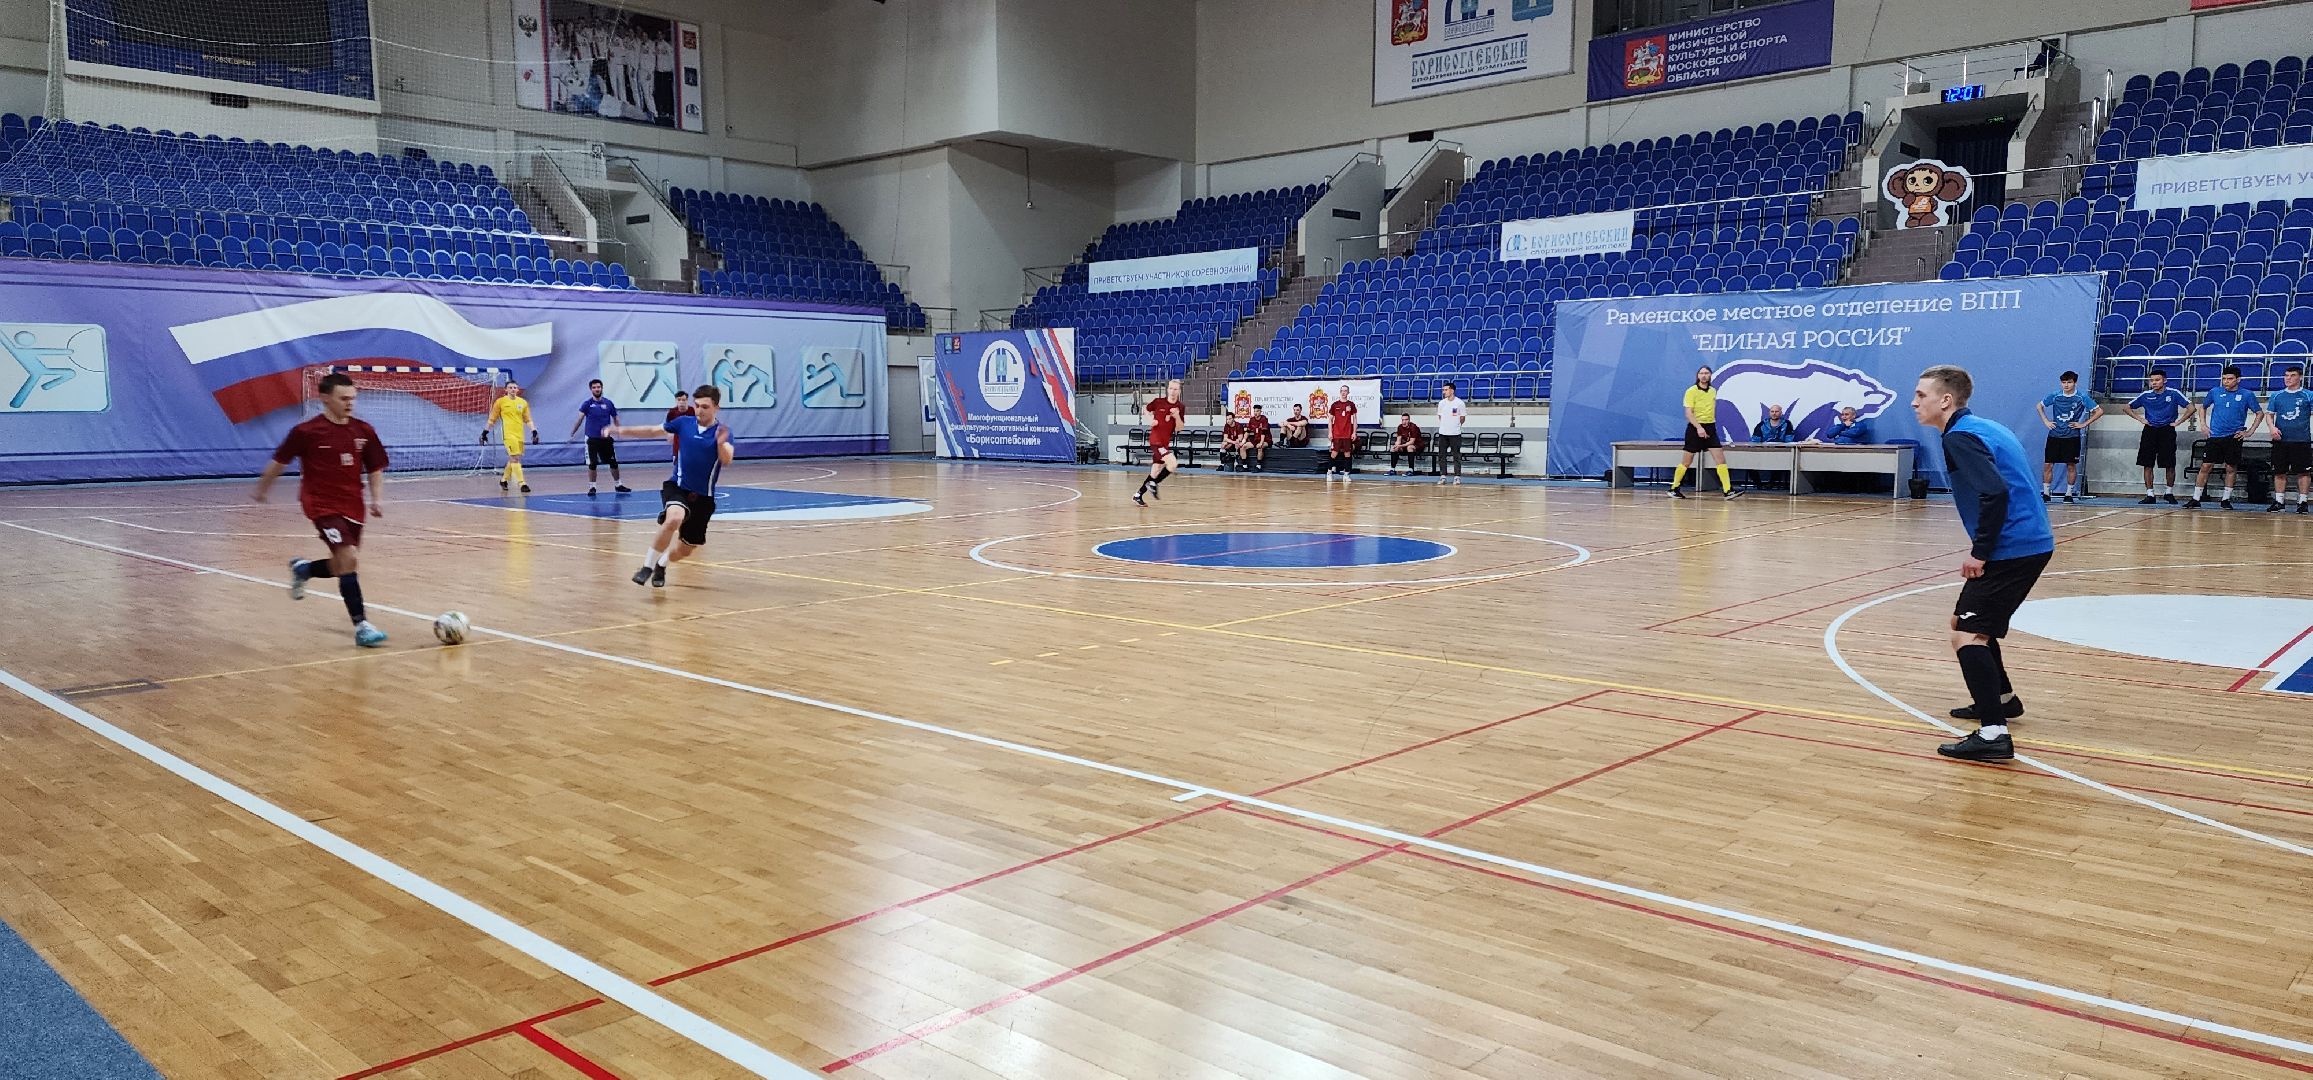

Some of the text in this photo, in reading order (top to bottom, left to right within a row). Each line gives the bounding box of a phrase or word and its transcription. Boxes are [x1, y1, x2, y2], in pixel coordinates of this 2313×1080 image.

[1668, 18, 1761, 41] МИНИСТЕРСТВО
[1668, 30, 1747, 52] ФИЗИЧЕСКОЙ
[1412, 39, 1528, 77] БОРИСОГЛЕБСКИЙ
[1668, 34, 1788, 62] КУЛЬТУРЫ И СПОРТА
[1667, 51, 1747, 72] МОСКОВСКОЙ
[1667, 67, 1720, 83] ОБЛАСТИ
[1945, 85, 1984, 102] 12:01
[2151, 172, 2313, 195] ПРИВЕТСТВУЕМ У
[1093, 273, 1144, 285] ПРИВЕТСТВУЕМ
[1145, 269, 1190, 281] УЧАСТНИКОВ
[1606, 290, 2023, 325] Раменское местное отделение ВПП
[1692, 326, 1911, 353] "ЕДИНАЯ РОССИЯ"
